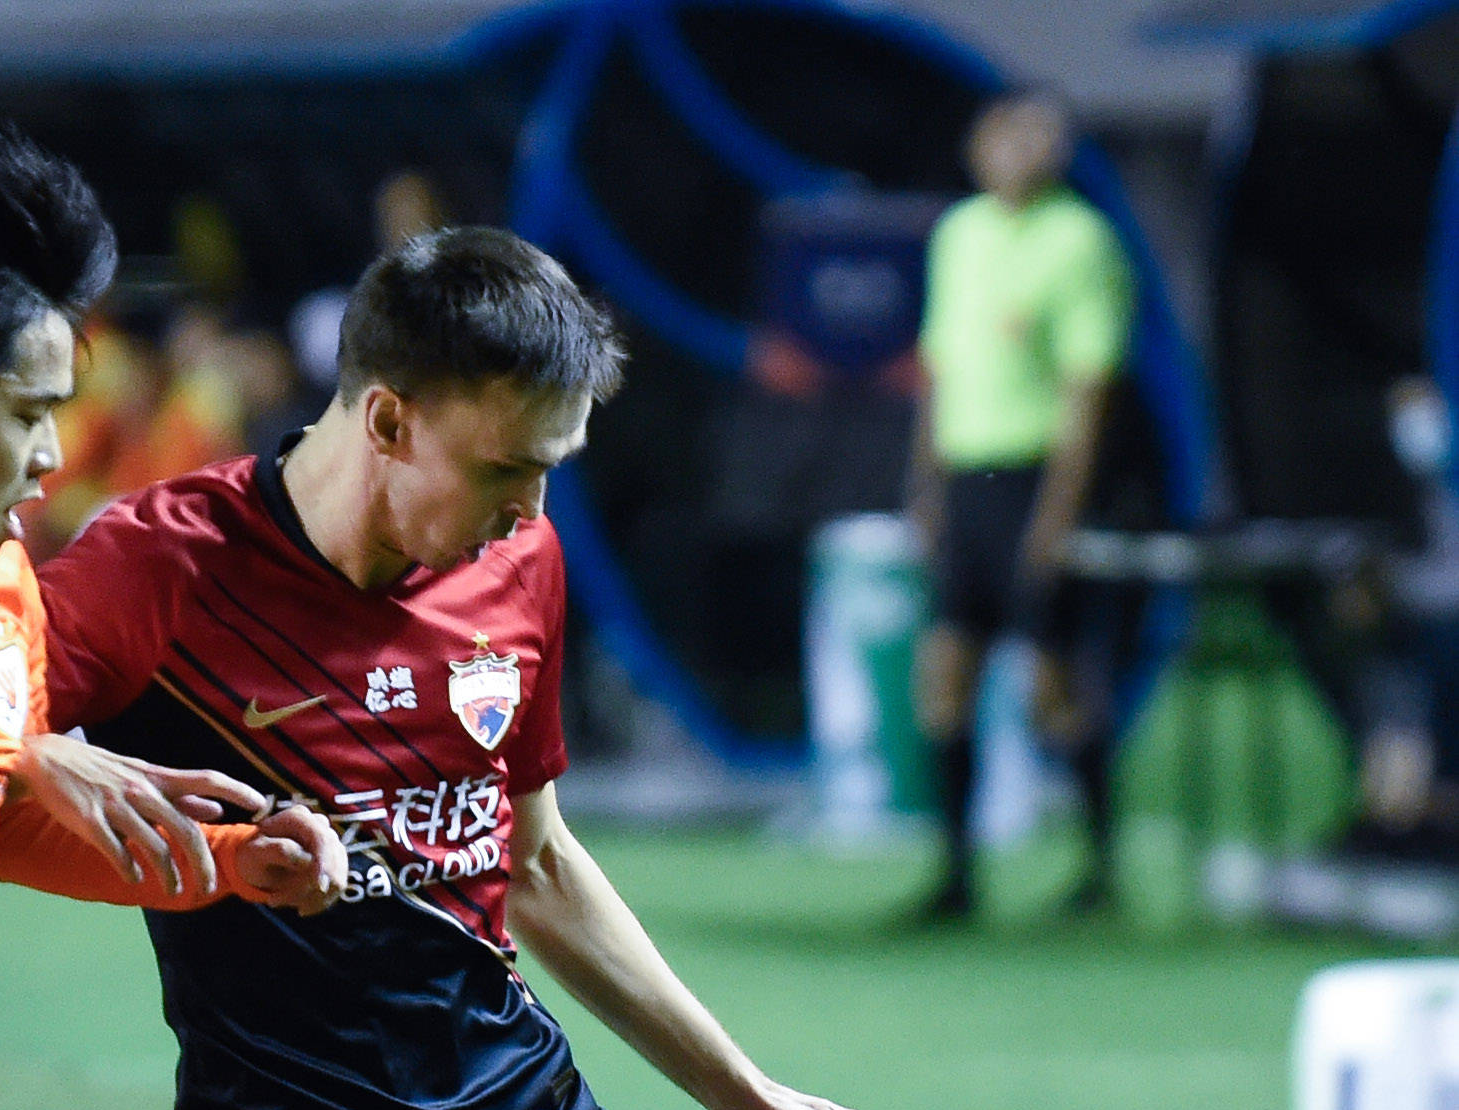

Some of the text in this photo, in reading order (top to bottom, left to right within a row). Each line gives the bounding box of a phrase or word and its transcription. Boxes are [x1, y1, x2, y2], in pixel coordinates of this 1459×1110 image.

[252, 775, 502, 851] 云科技
[397, 835, 501, 891] CLOUD
